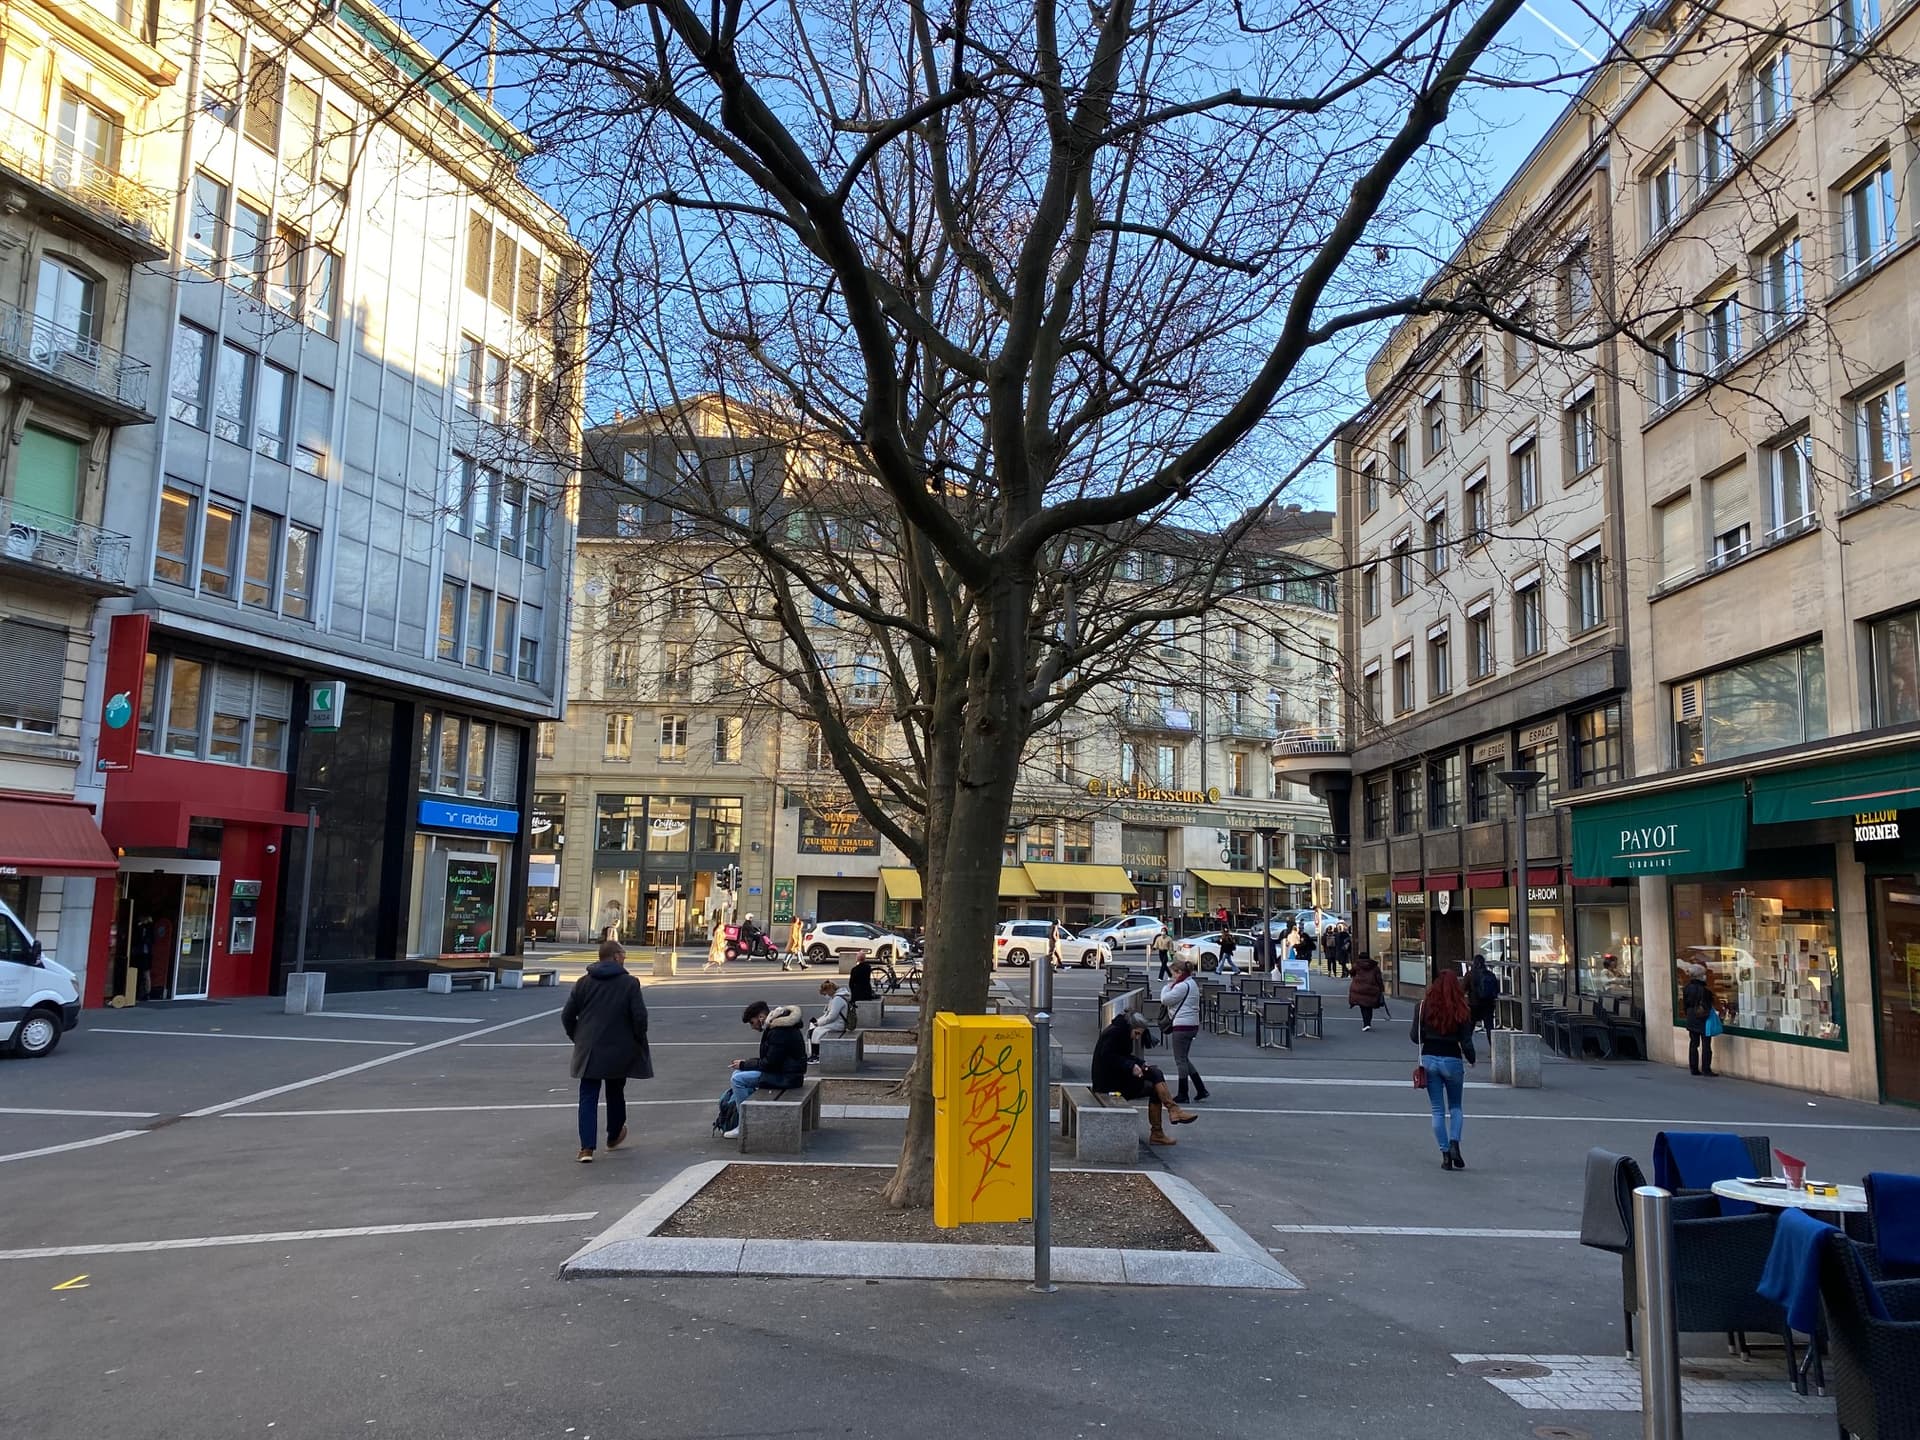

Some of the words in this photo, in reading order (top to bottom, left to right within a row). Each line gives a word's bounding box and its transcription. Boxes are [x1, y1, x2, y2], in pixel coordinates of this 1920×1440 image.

[1529, 724, 1553, 742] ESPACE
[1107, 781, 1131, 799] Les
[1137, 783, 1205, 804] Brasseurs
[461, 813, 498, 827] randstad
[824, 813, 858, 823] OUVERT
[1225, 815, 1246, 827] Mets
[1248, 818, 1257, 828] de
[1259, 818, 1294, 831] Brasserie
[1855, 809, 1897, 824] YELLOW
[653, 818, 685, 830] Coiffure
[831, 823, 850, 836] 7/7
[1620, 824, 1679, 851] PAYOT
[1854, 823, 1900, 842] KORNER
[805, 837, 838, 845] CUISINE
[1121, 852, 1167, 866] Brasseurs
[1397, 893, 1424, 905] BOULANGERIE
[1527, 887, 1557, 901] EA-ROOM
